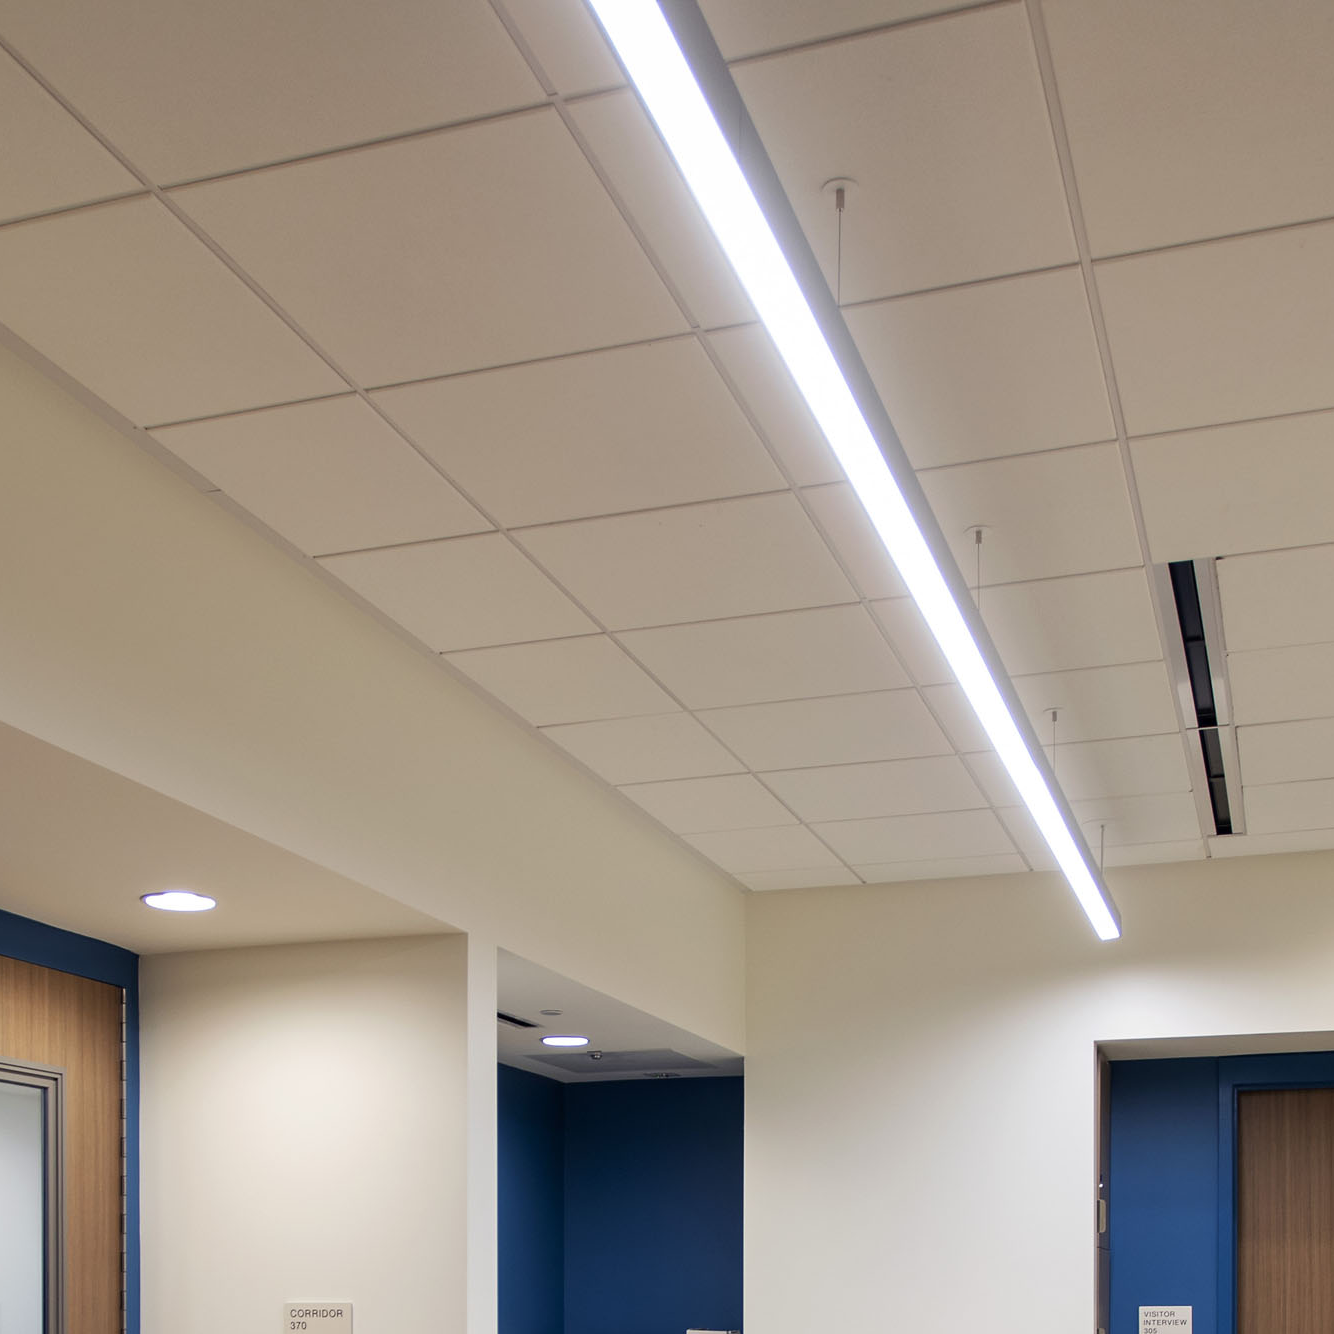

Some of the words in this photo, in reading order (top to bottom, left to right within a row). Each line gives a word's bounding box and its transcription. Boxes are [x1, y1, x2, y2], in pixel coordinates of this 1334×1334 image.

[290, 1308, 344, 1318] CORRIDOR
[1143, 1310, 1176, 1318] VISITOR
[290, 1321, 307, 1330] 370
